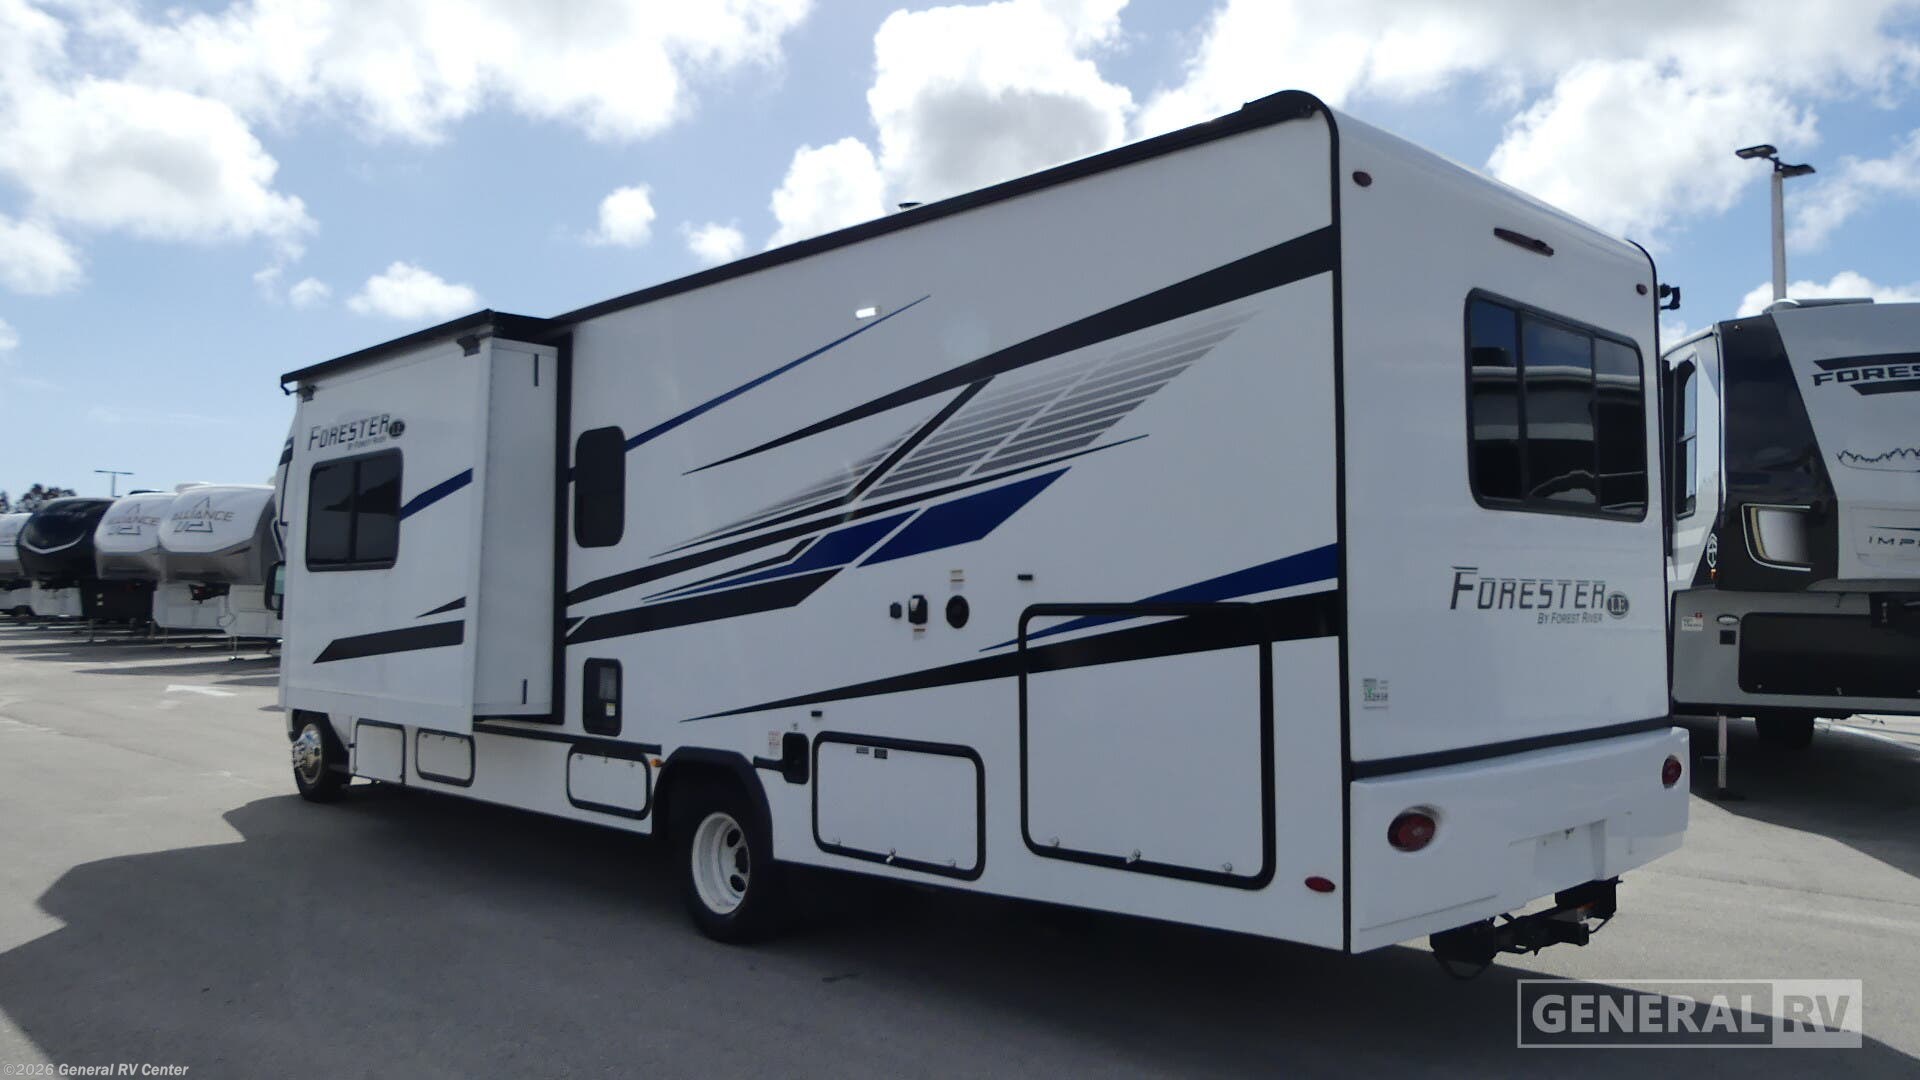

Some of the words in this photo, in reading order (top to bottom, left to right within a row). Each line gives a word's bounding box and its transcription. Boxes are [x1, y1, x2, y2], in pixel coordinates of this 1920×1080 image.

[307, 413, 390, 451] FORESTER
[171, 509, 236, 522] ALLIANCE
[1868, 536, 1920, 546] IMP
[1450, 566, 1606, 610] FORESTER
[1537, 612, 1550, 625] BY
[1551, 612, 1580, 625] FOREST
[1582, 612, 1603, 624] RIVER
